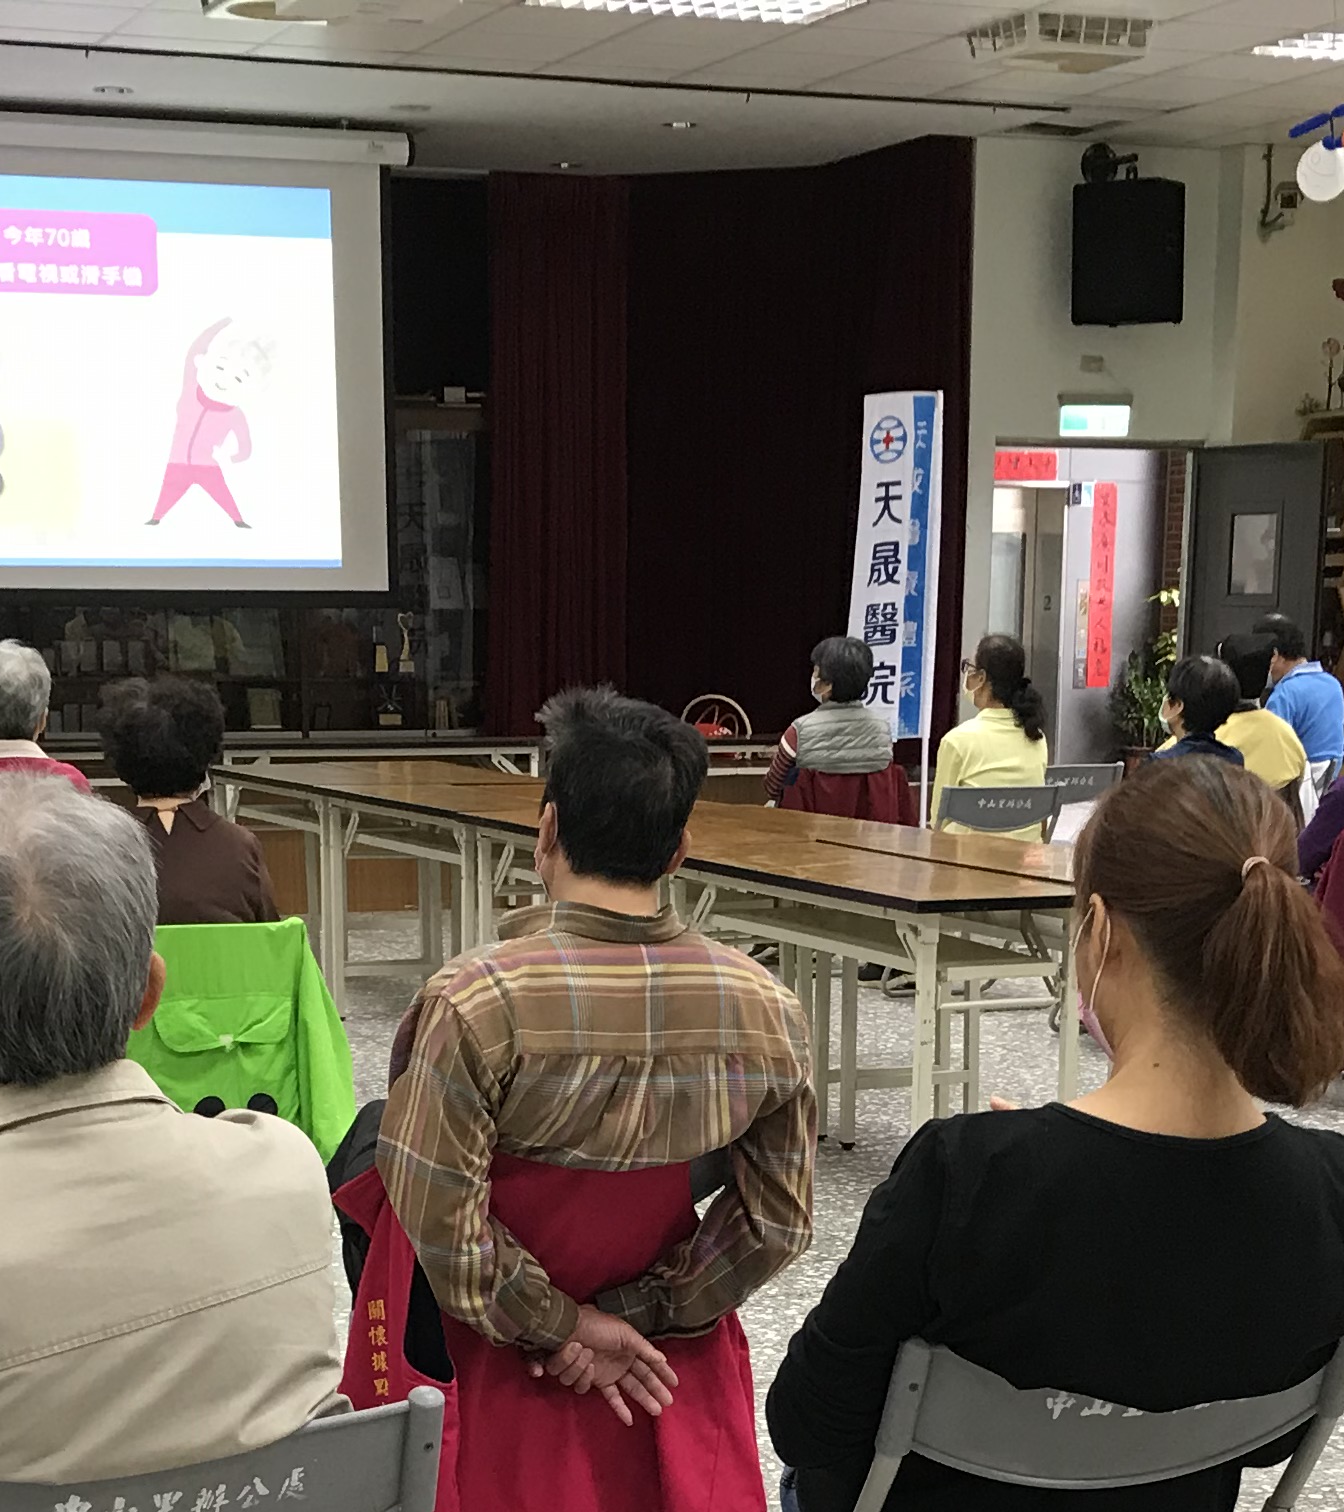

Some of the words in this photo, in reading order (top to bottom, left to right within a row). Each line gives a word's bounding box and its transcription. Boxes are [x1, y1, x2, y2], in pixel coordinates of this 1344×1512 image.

[861, 479, 903, 706] 天晟醫院
[368, 1299, 389, 1404] 關懷據點
